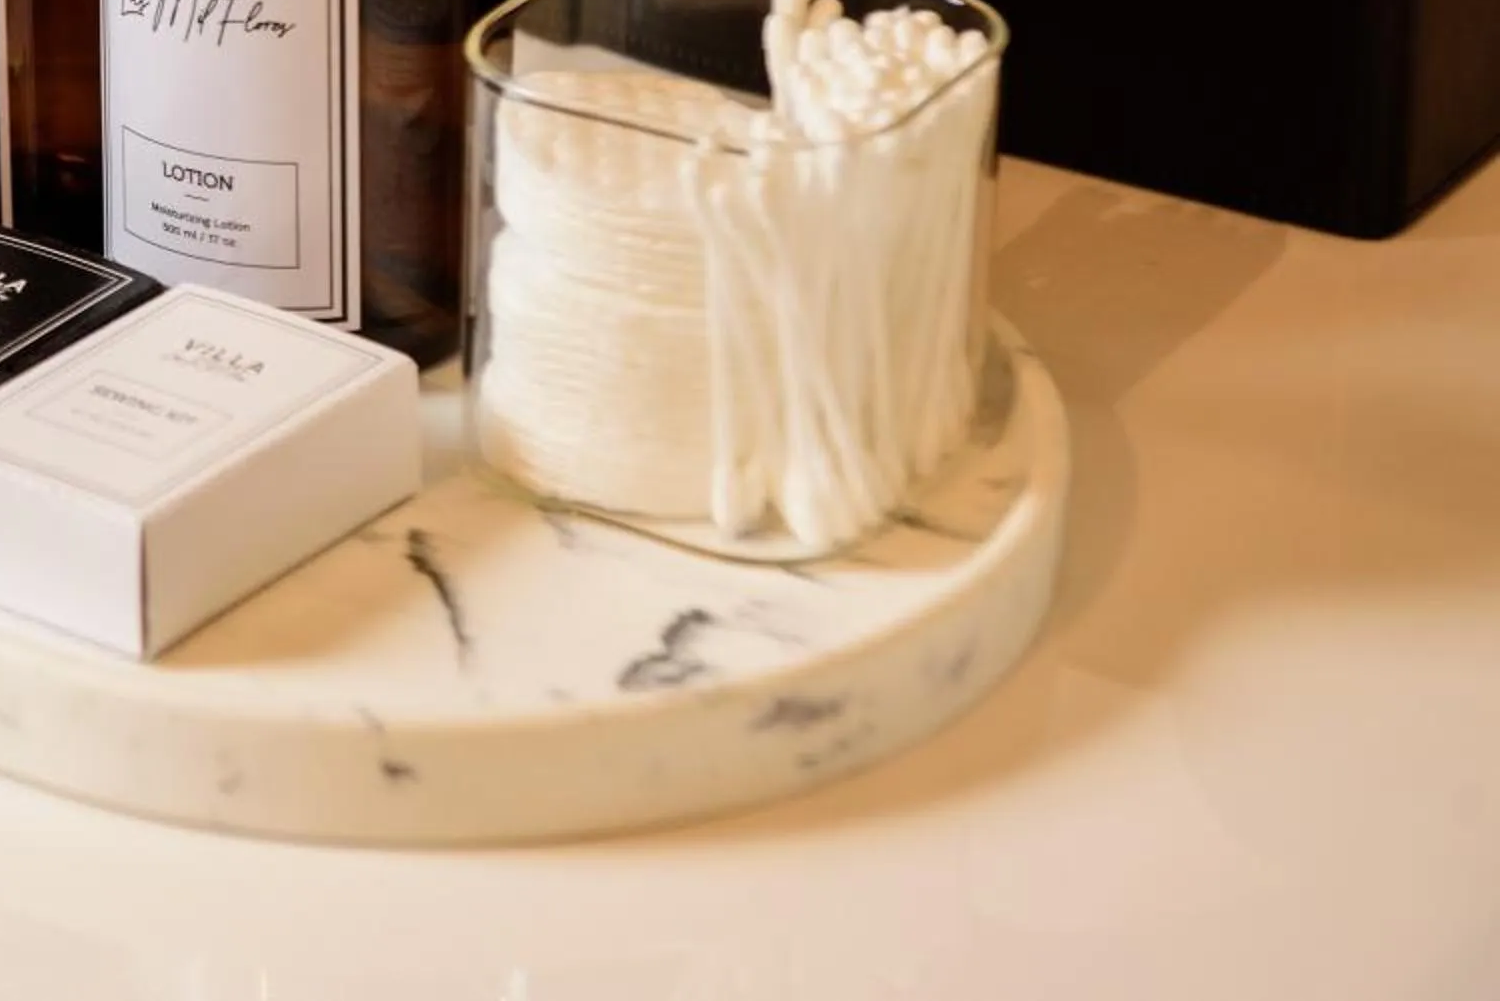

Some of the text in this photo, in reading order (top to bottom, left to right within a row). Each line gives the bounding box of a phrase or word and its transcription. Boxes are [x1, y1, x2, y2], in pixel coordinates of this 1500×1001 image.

[162, 160, 235, 192] LOTION
[151, 201, 251, 232] Moisturizing Lotion
[163, 222, 181, 236] 500
[209, 234, 219, 244] 17
[185, 338, 266, 376] VILLA
